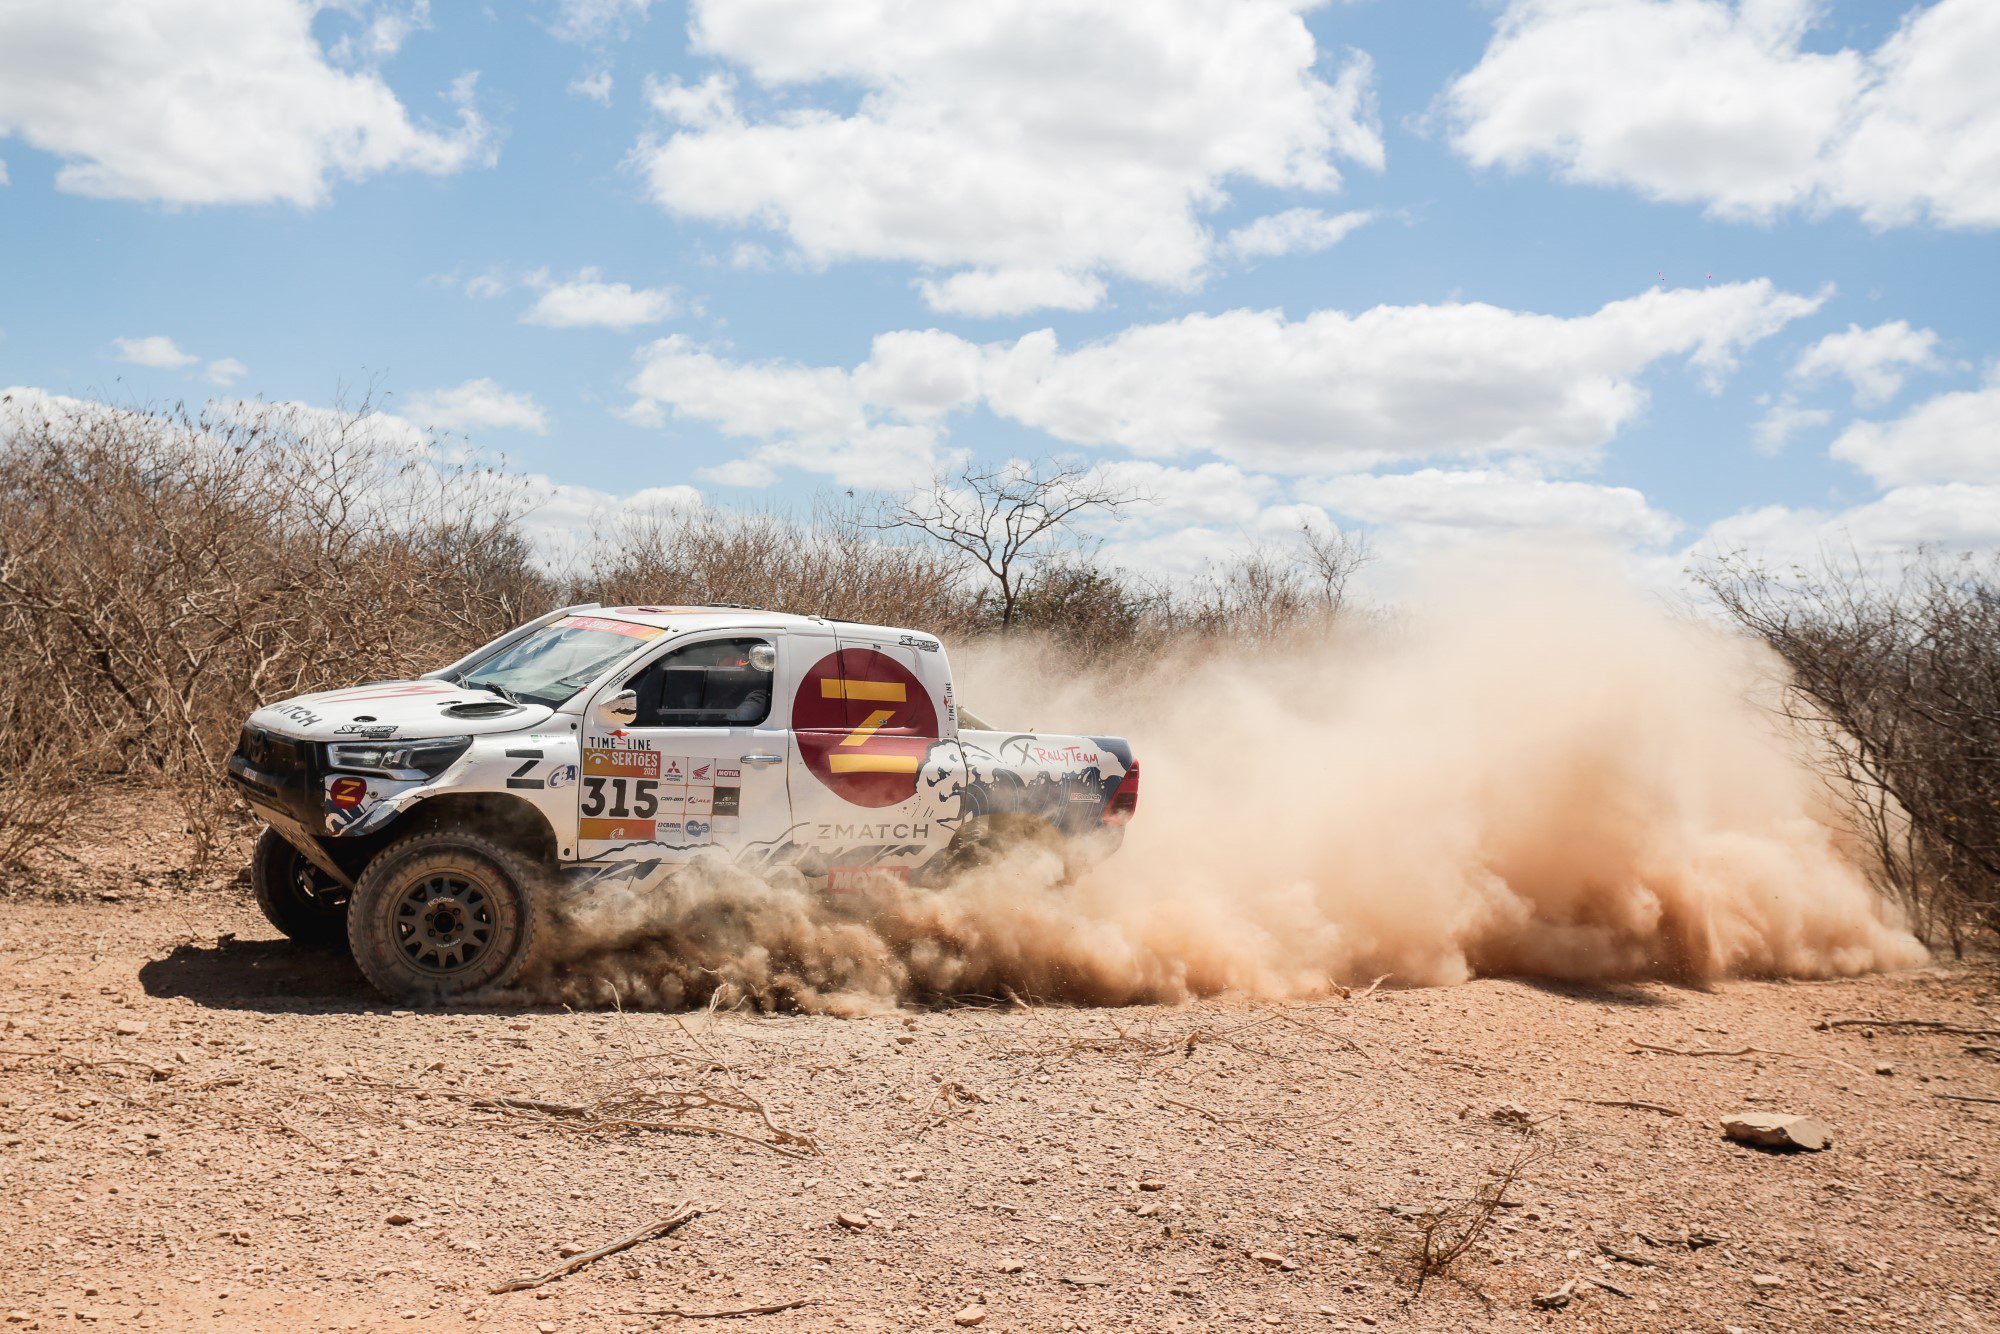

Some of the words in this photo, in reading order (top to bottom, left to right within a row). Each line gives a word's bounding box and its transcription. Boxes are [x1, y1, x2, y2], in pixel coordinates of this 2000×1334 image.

[945, 682, 953, 698] LINE
[820, 678, 919, 774] Z
[588, 736, 616, 749] TIME
[627, 738, 652, 751] LINE
[1013, 742, 1041, 767] X
[505, 749, 545, 790] Z
[643, 767, 657, 776] 2021
[336, 780, 361, 802] Z
[581, 777, 659, 819] 315
[817, 823, 929, 840] ZMATCH
